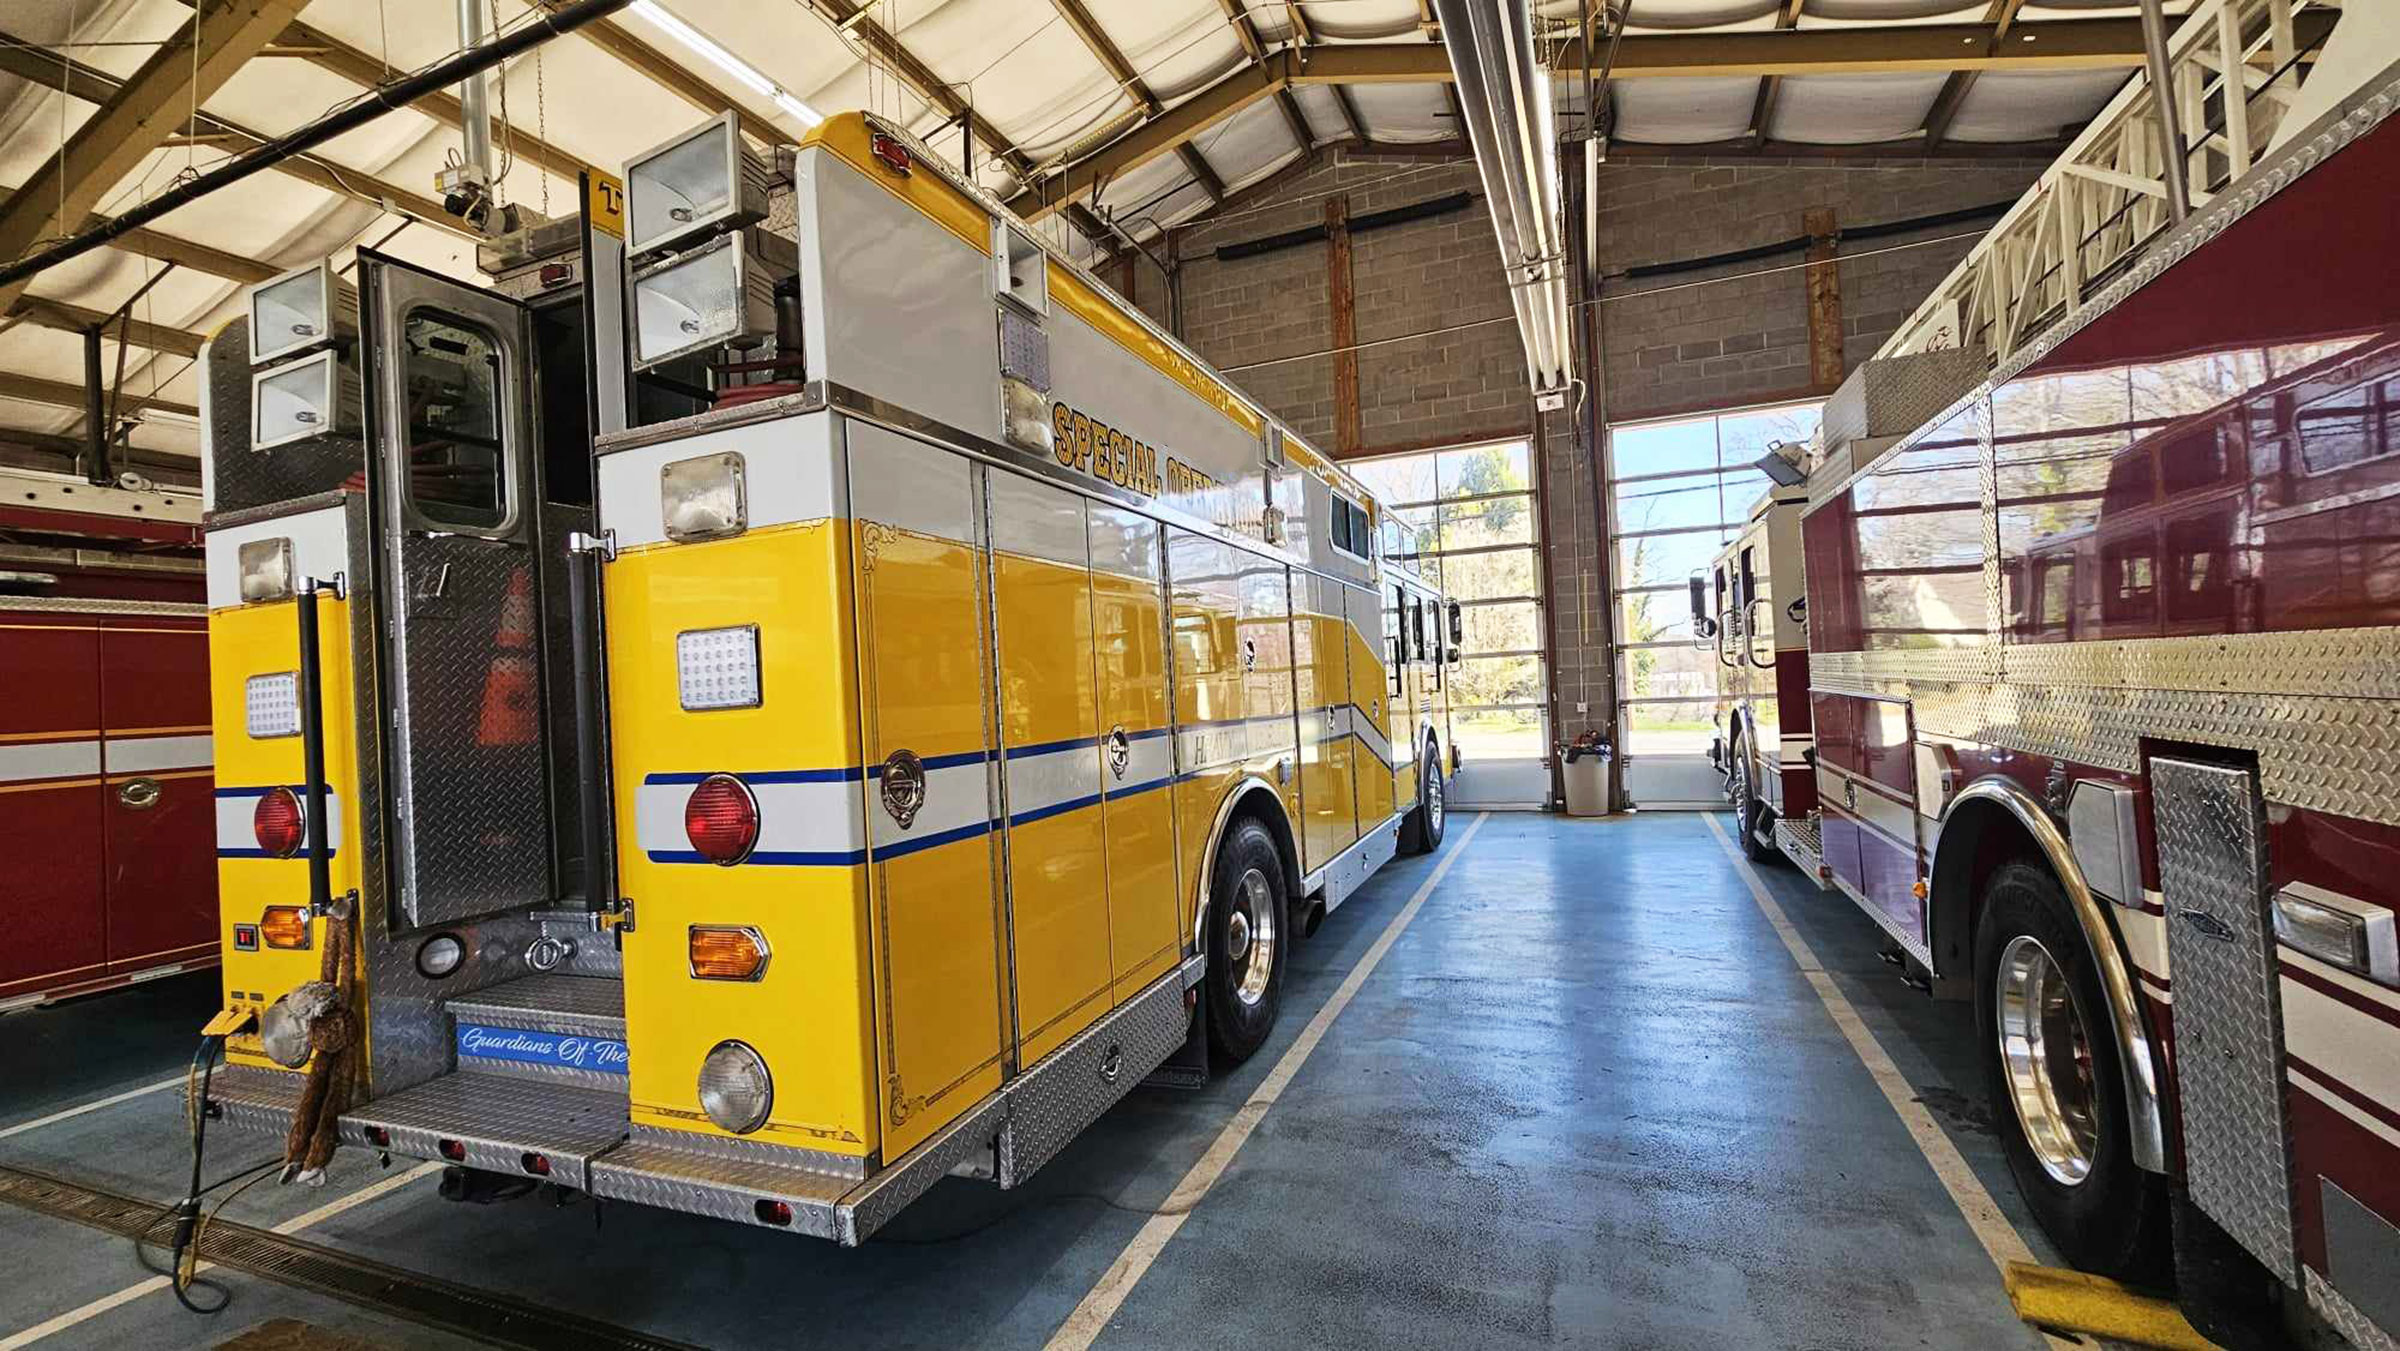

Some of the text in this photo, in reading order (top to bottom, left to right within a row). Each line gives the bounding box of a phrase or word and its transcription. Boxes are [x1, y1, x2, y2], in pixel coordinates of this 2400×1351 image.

[1053, 401, 1163, 499] SPECIAL
[462, 1027, 629, 1066] Guardians Of The
